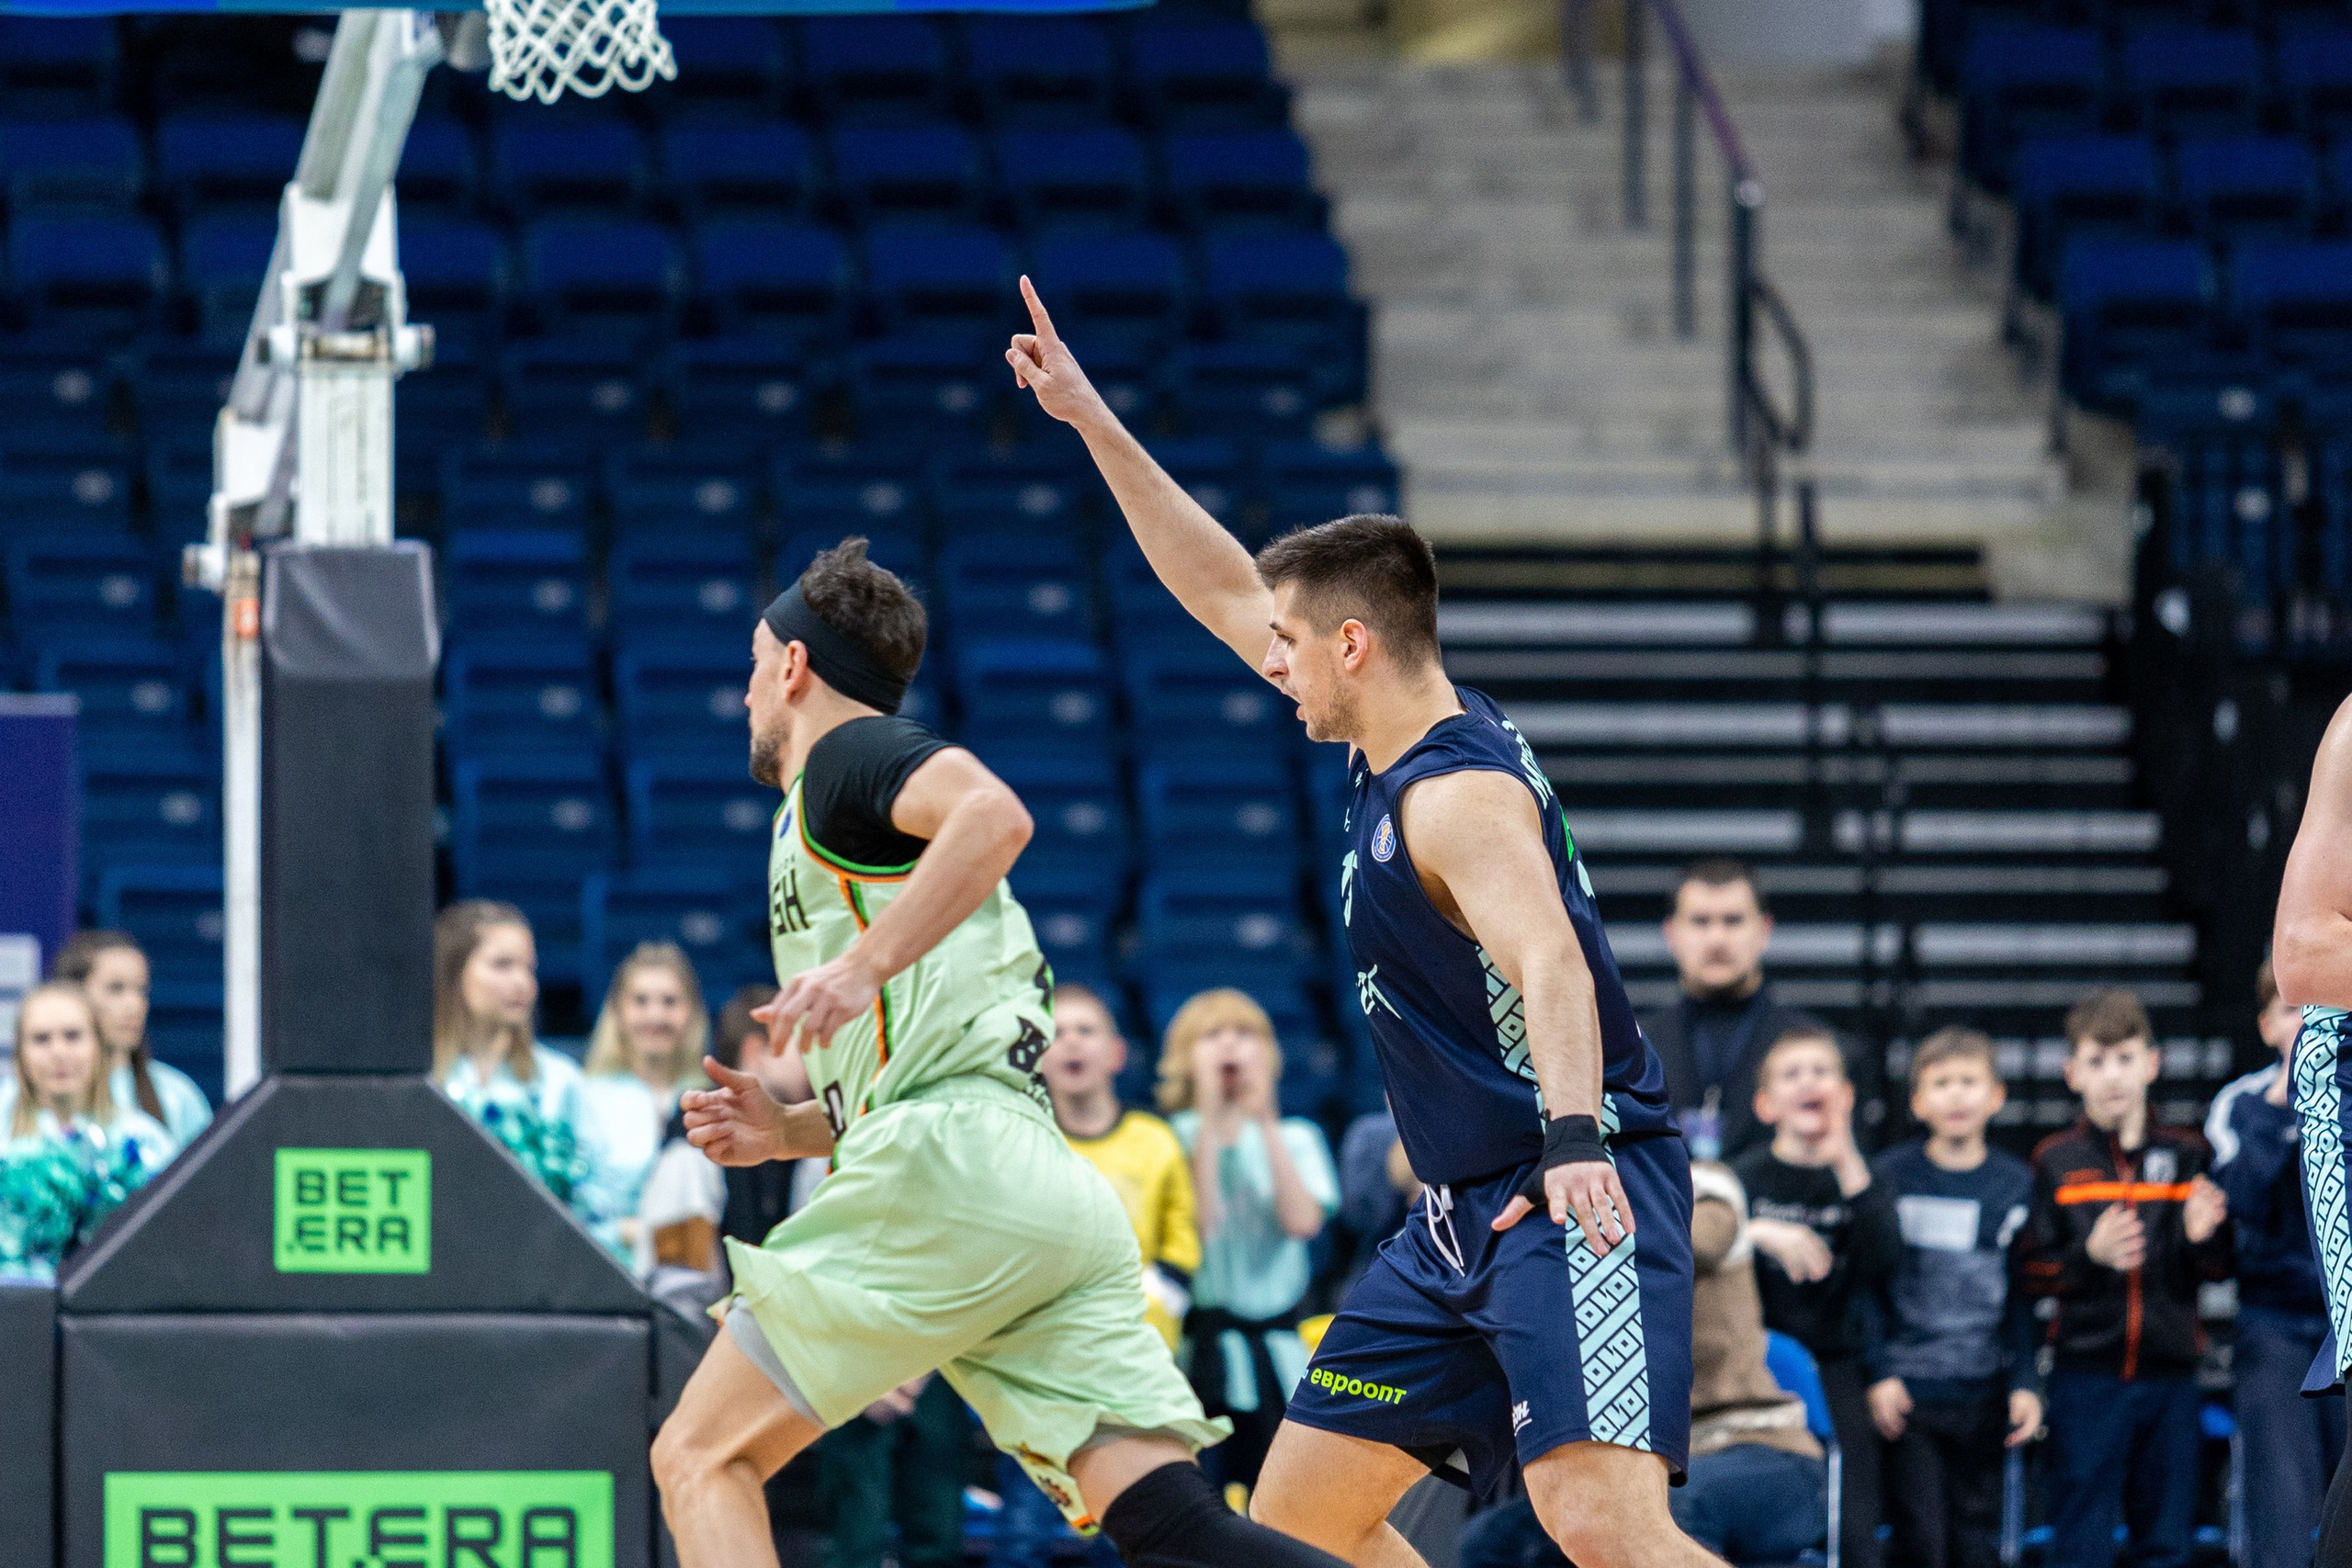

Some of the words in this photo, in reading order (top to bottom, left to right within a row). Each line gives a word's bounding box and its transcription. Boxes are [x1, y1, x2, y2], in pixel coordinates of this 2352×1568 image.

[295, 1168, 411, 1207] BET
[284, 1215, 411, 1253] .ERA
[1310, 1368, 1408, 1404] евроопт
[140, 1507, 578, 1568] BET.ERA
